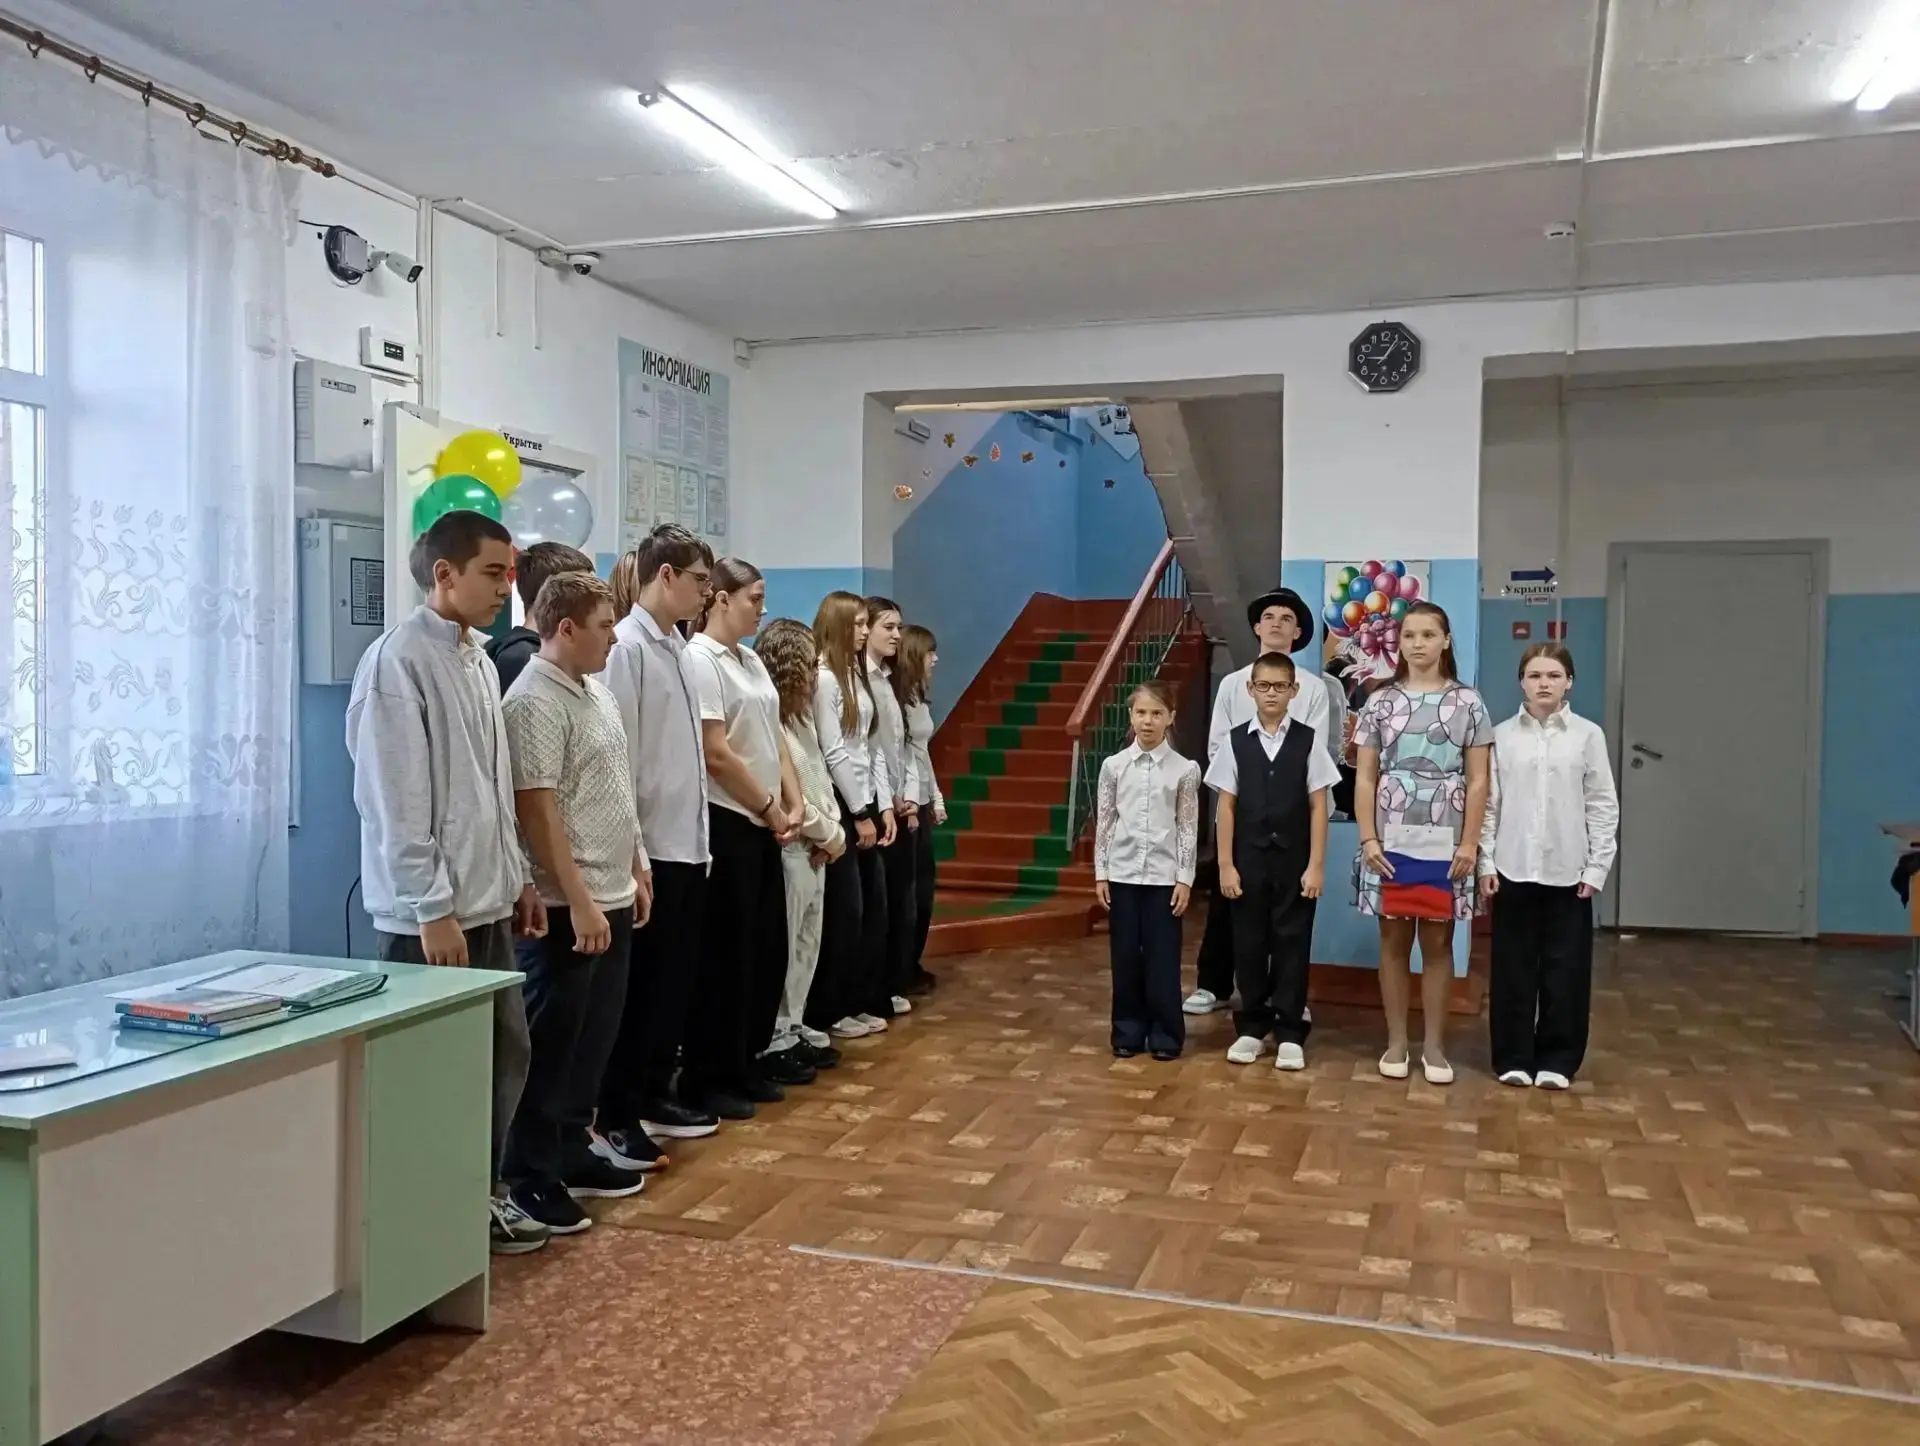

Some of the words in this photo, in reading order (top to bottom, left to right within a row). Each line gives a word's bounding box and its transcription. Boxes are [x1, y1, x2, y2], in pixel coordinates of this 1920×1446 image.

[1371, 335, 1377, 344] 11
[1381, 331, 1391, 341] 12
[1361, 344, 1372, 353] 10
[1400, 340, 1409, 351] 2
[1357, 354, 1365, 364] 9
[1404, 351, 1412, 362] 3
[642, 348, 711, 396] ИНФОРМАЦИЯ
[1361, 365, 1368, 375] 8
[1400, 363, 1407, 372] 4
[1370, 373, 1378, 383] 7
[1380, 375, 1387, 385] 6
[1391, 371, 1399, 382] 5
[503, 432, 543, 451] Укрытие
[1505, 585, 1556, 596] Укрытие
